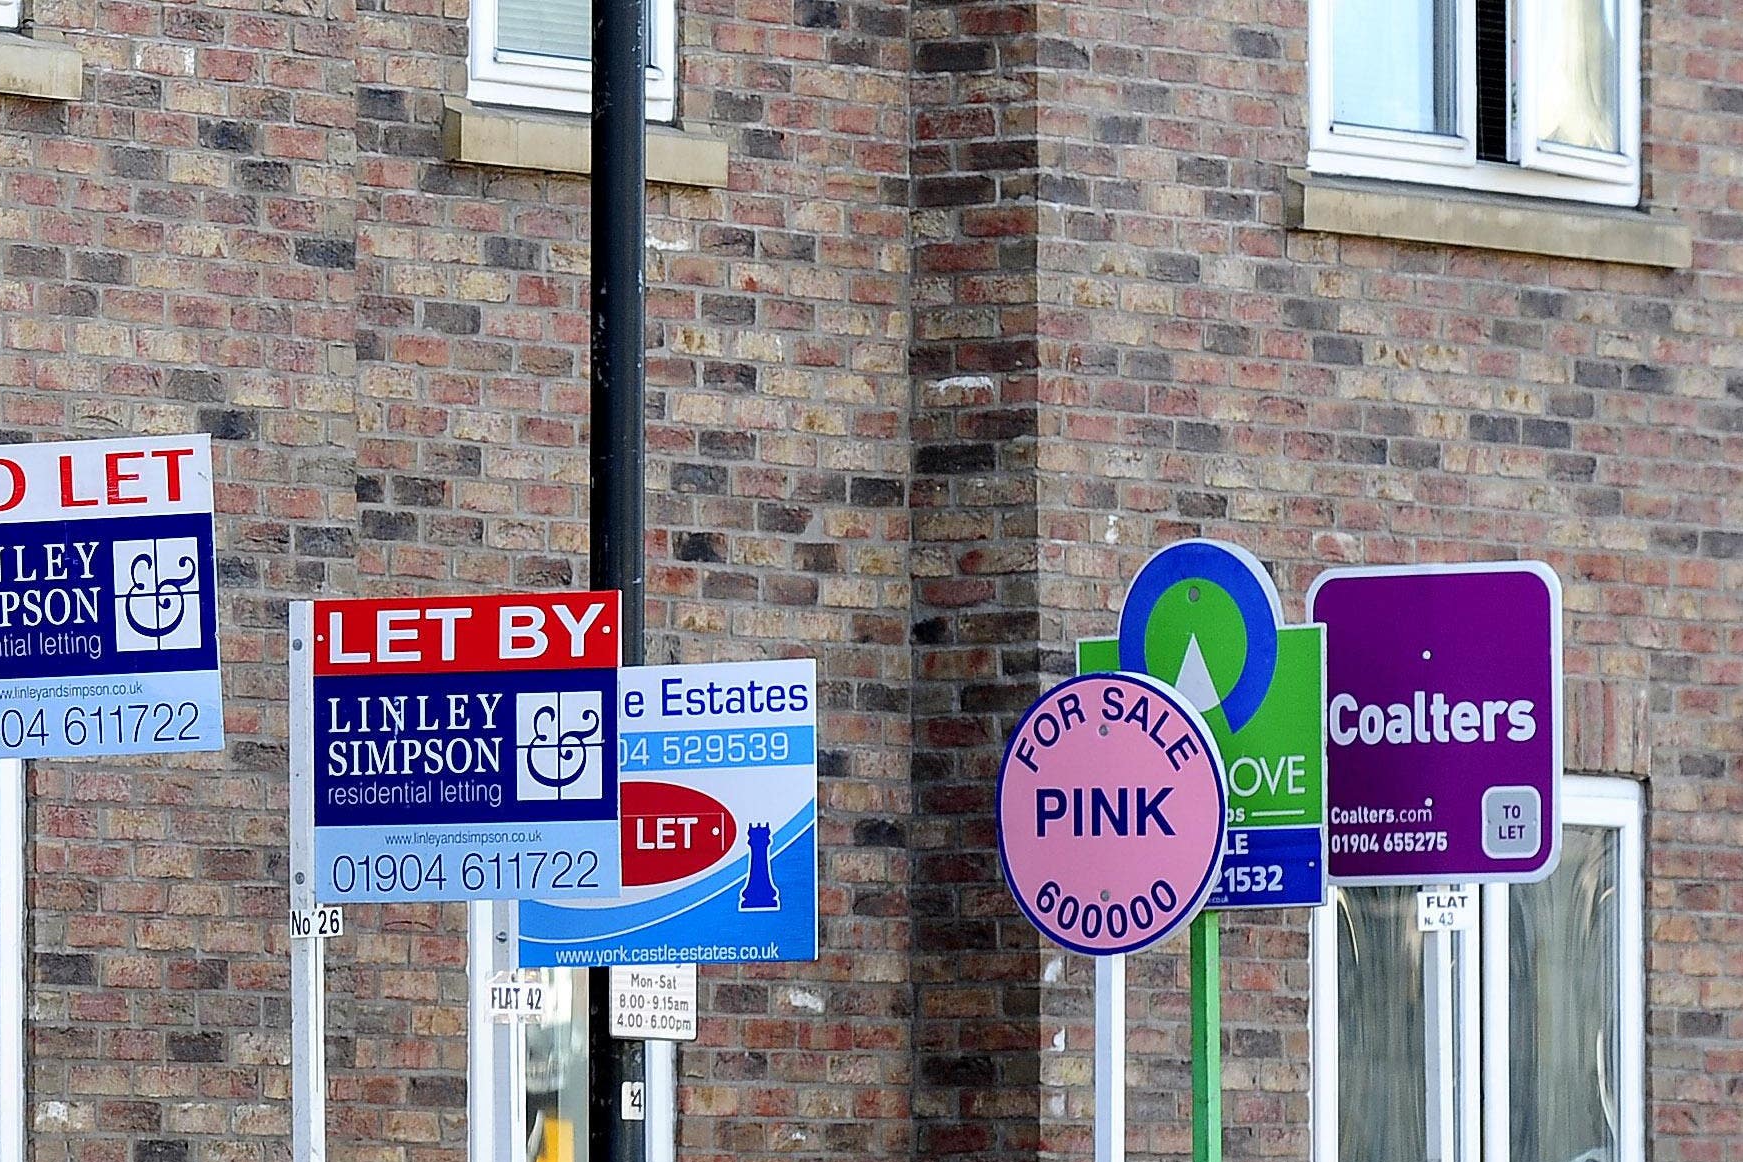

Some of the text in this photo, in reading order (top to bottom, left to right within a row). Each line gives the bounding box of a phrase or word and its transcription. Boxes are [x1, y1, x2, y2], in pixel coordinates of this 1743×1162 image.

[58, 448, 195, 509] LET
[39, 630, 103, 661] letting
[327, 602, 607, 667] LET BY
[327, 692, 504, 734] LINLEY
[660, 676, 809, 718] Estates
[63, 700, 202, 746] 611722
[1014, 686, 1200, 775] FOR SALE
[1328, 689, 1537, 747] Coalters
[327, 736, 504, 778] SIMPSON
[661, 730, 790, 766] 529539
[328, 778, 503, 808] residential letting
[1228, 754, 1306, 798] OVE
[1035, 786, 1177, 838] PINK
[1330, 804, 1433, 826] Coalters.com
[1501, 804, 1522, 821] TO
[384, 828, 543, 848] www.linleyandsimpson.co.uk
[635, 816, 699, 850] LET
[1223, 832, 1249, 856] LE
[1330, 830, 1449, 854] 01904 655275
[1497, 824, 1527, 841] LET
[332, 849, 600, 893] 01904 611722
[1212, 864, 1284, 894] 21532
[1035, 879, 1178, 940] 600000
[1426, 895, 1469, 909] FLAT
[1438, 911, 1455, 927] 43
[317, 908, 340, 935] 26
[491, 986, 543, 1010] FLAT 42
